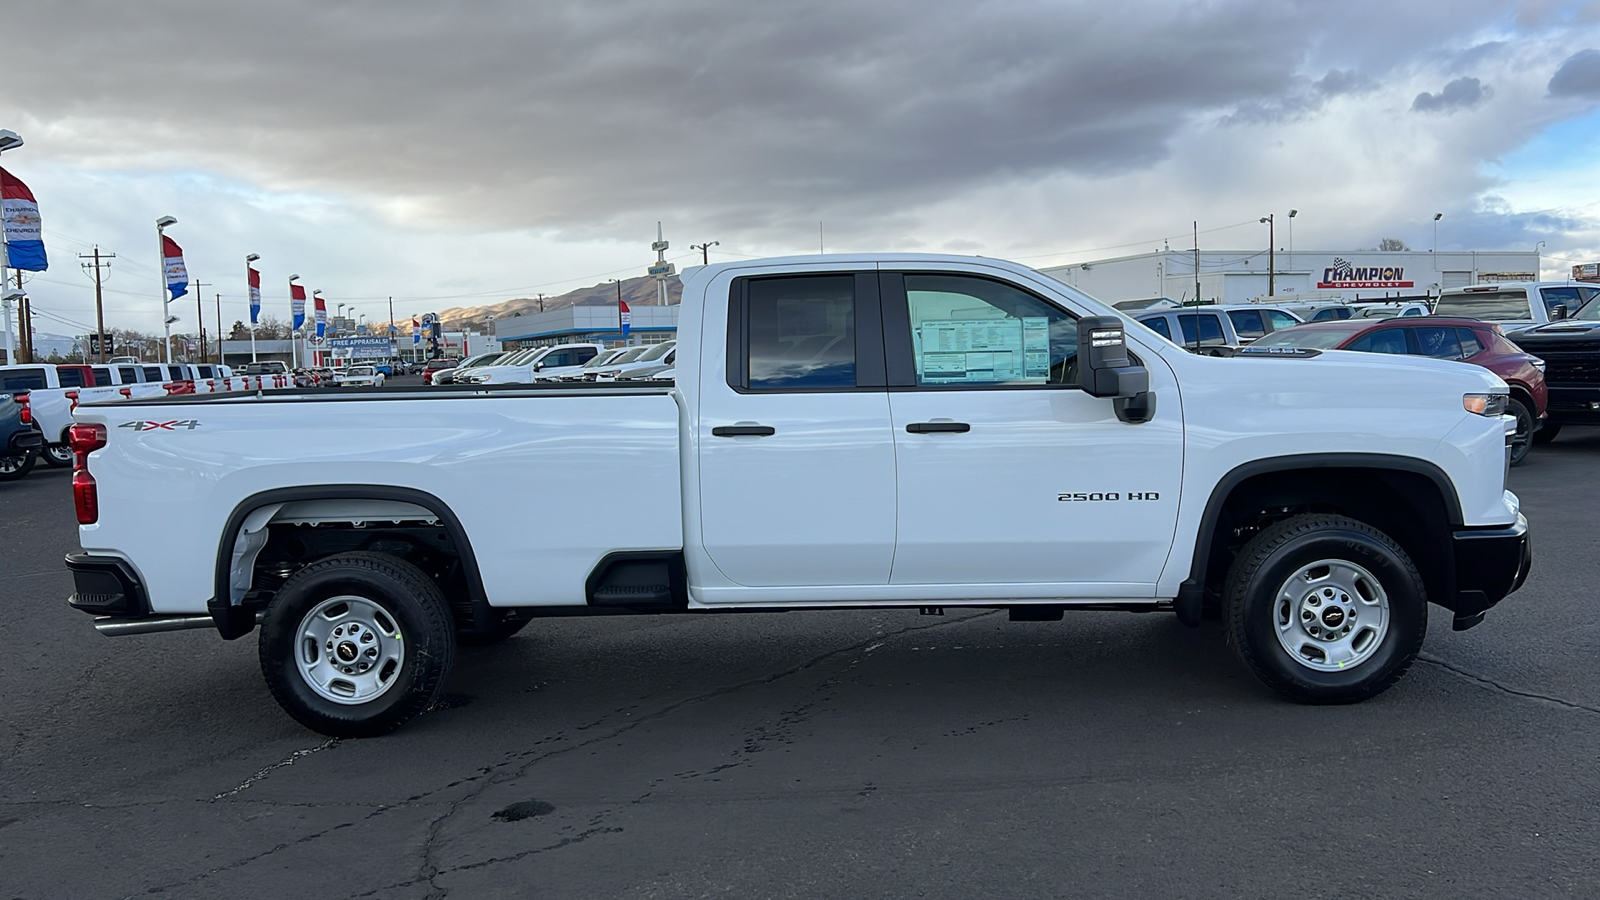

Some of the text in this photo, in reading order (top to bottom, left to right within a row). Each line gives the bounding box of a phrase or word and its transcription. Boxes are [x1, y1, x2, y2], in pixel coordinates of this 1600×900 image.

[1323, 267, 1404, 285] CHAMPION
[1057, 492, 1160, 502] 2500 HD
